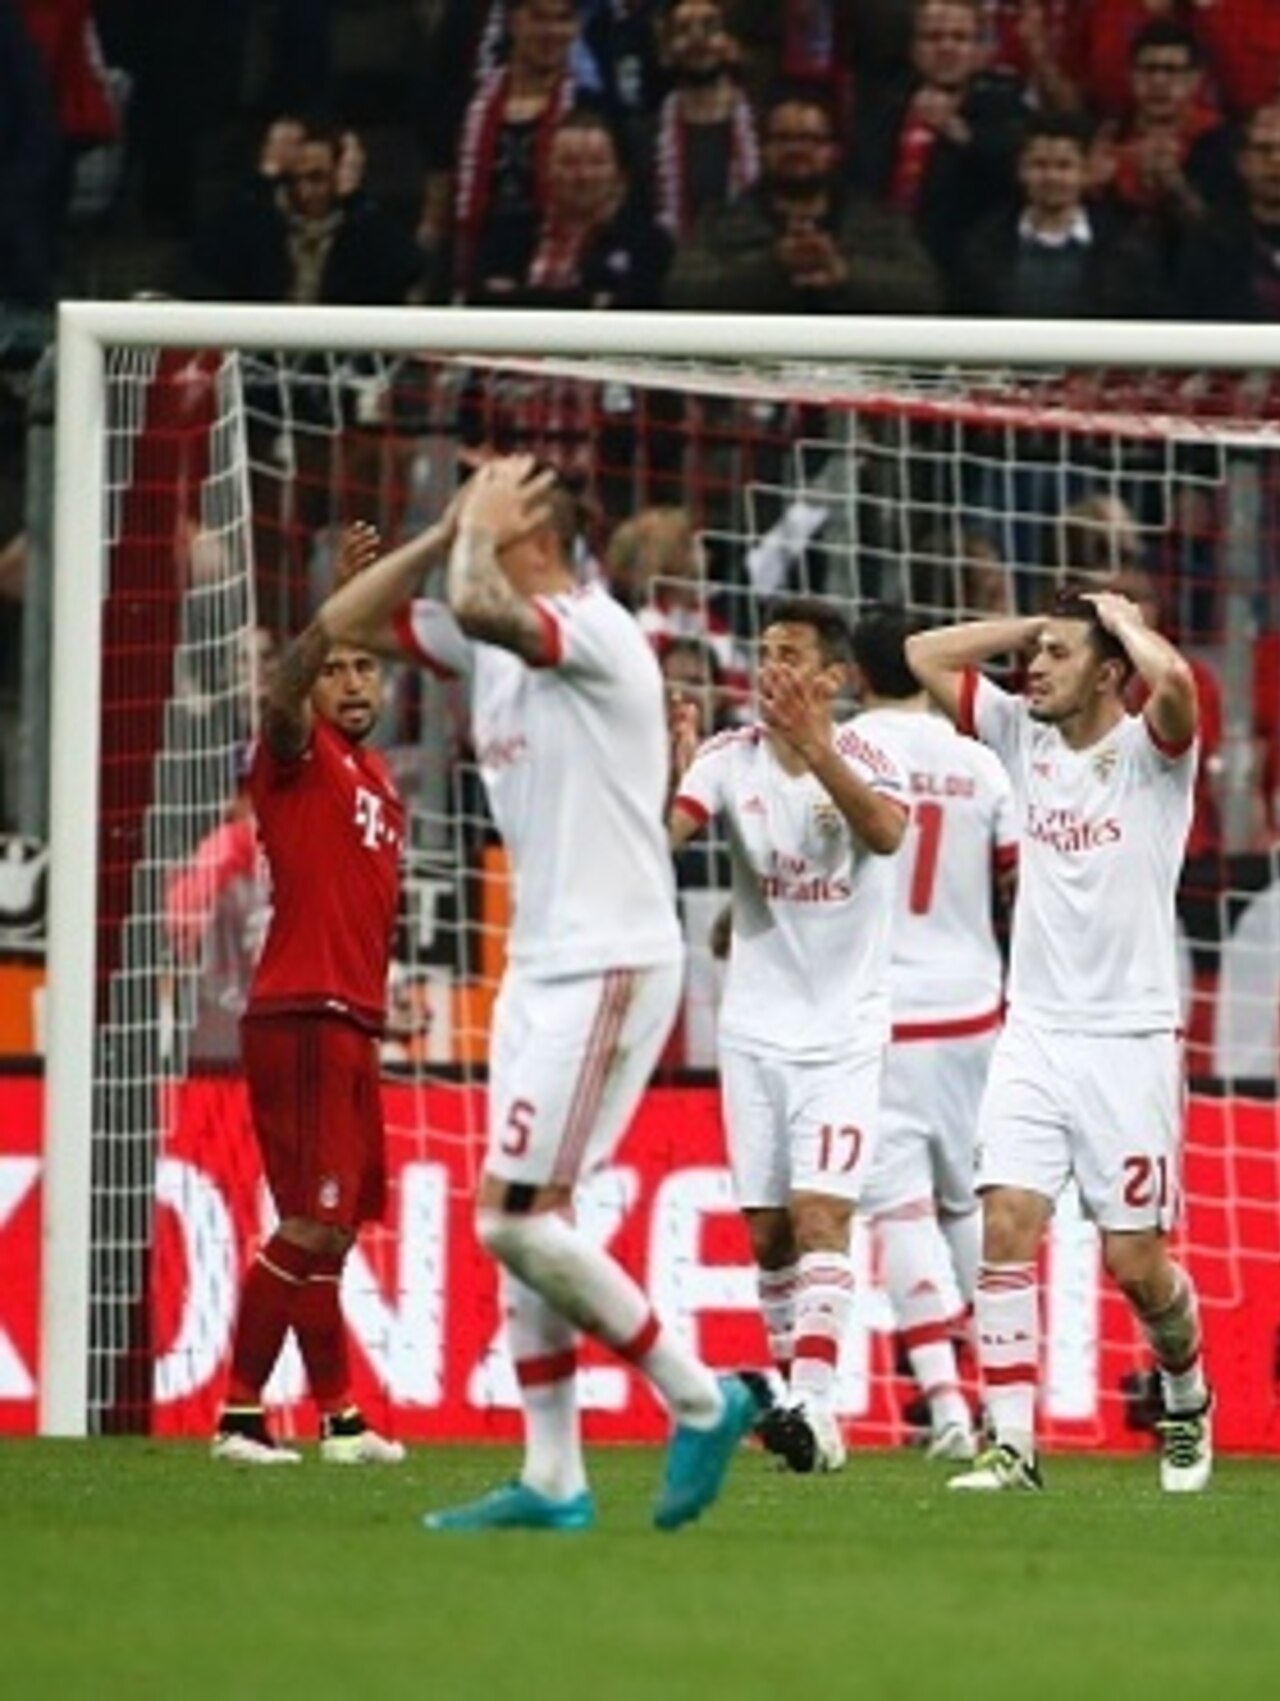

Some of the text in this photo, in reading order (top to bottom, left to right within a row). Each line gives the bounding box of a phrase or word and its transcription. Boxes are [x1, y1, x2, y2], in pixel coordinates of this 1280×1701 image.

[909, 801, 943, 916] 1
[501, 1099, 536, 1157] 5
[818, 1125, 862, 1172] 17
[1123, 1154, 1166, 1208] 21
